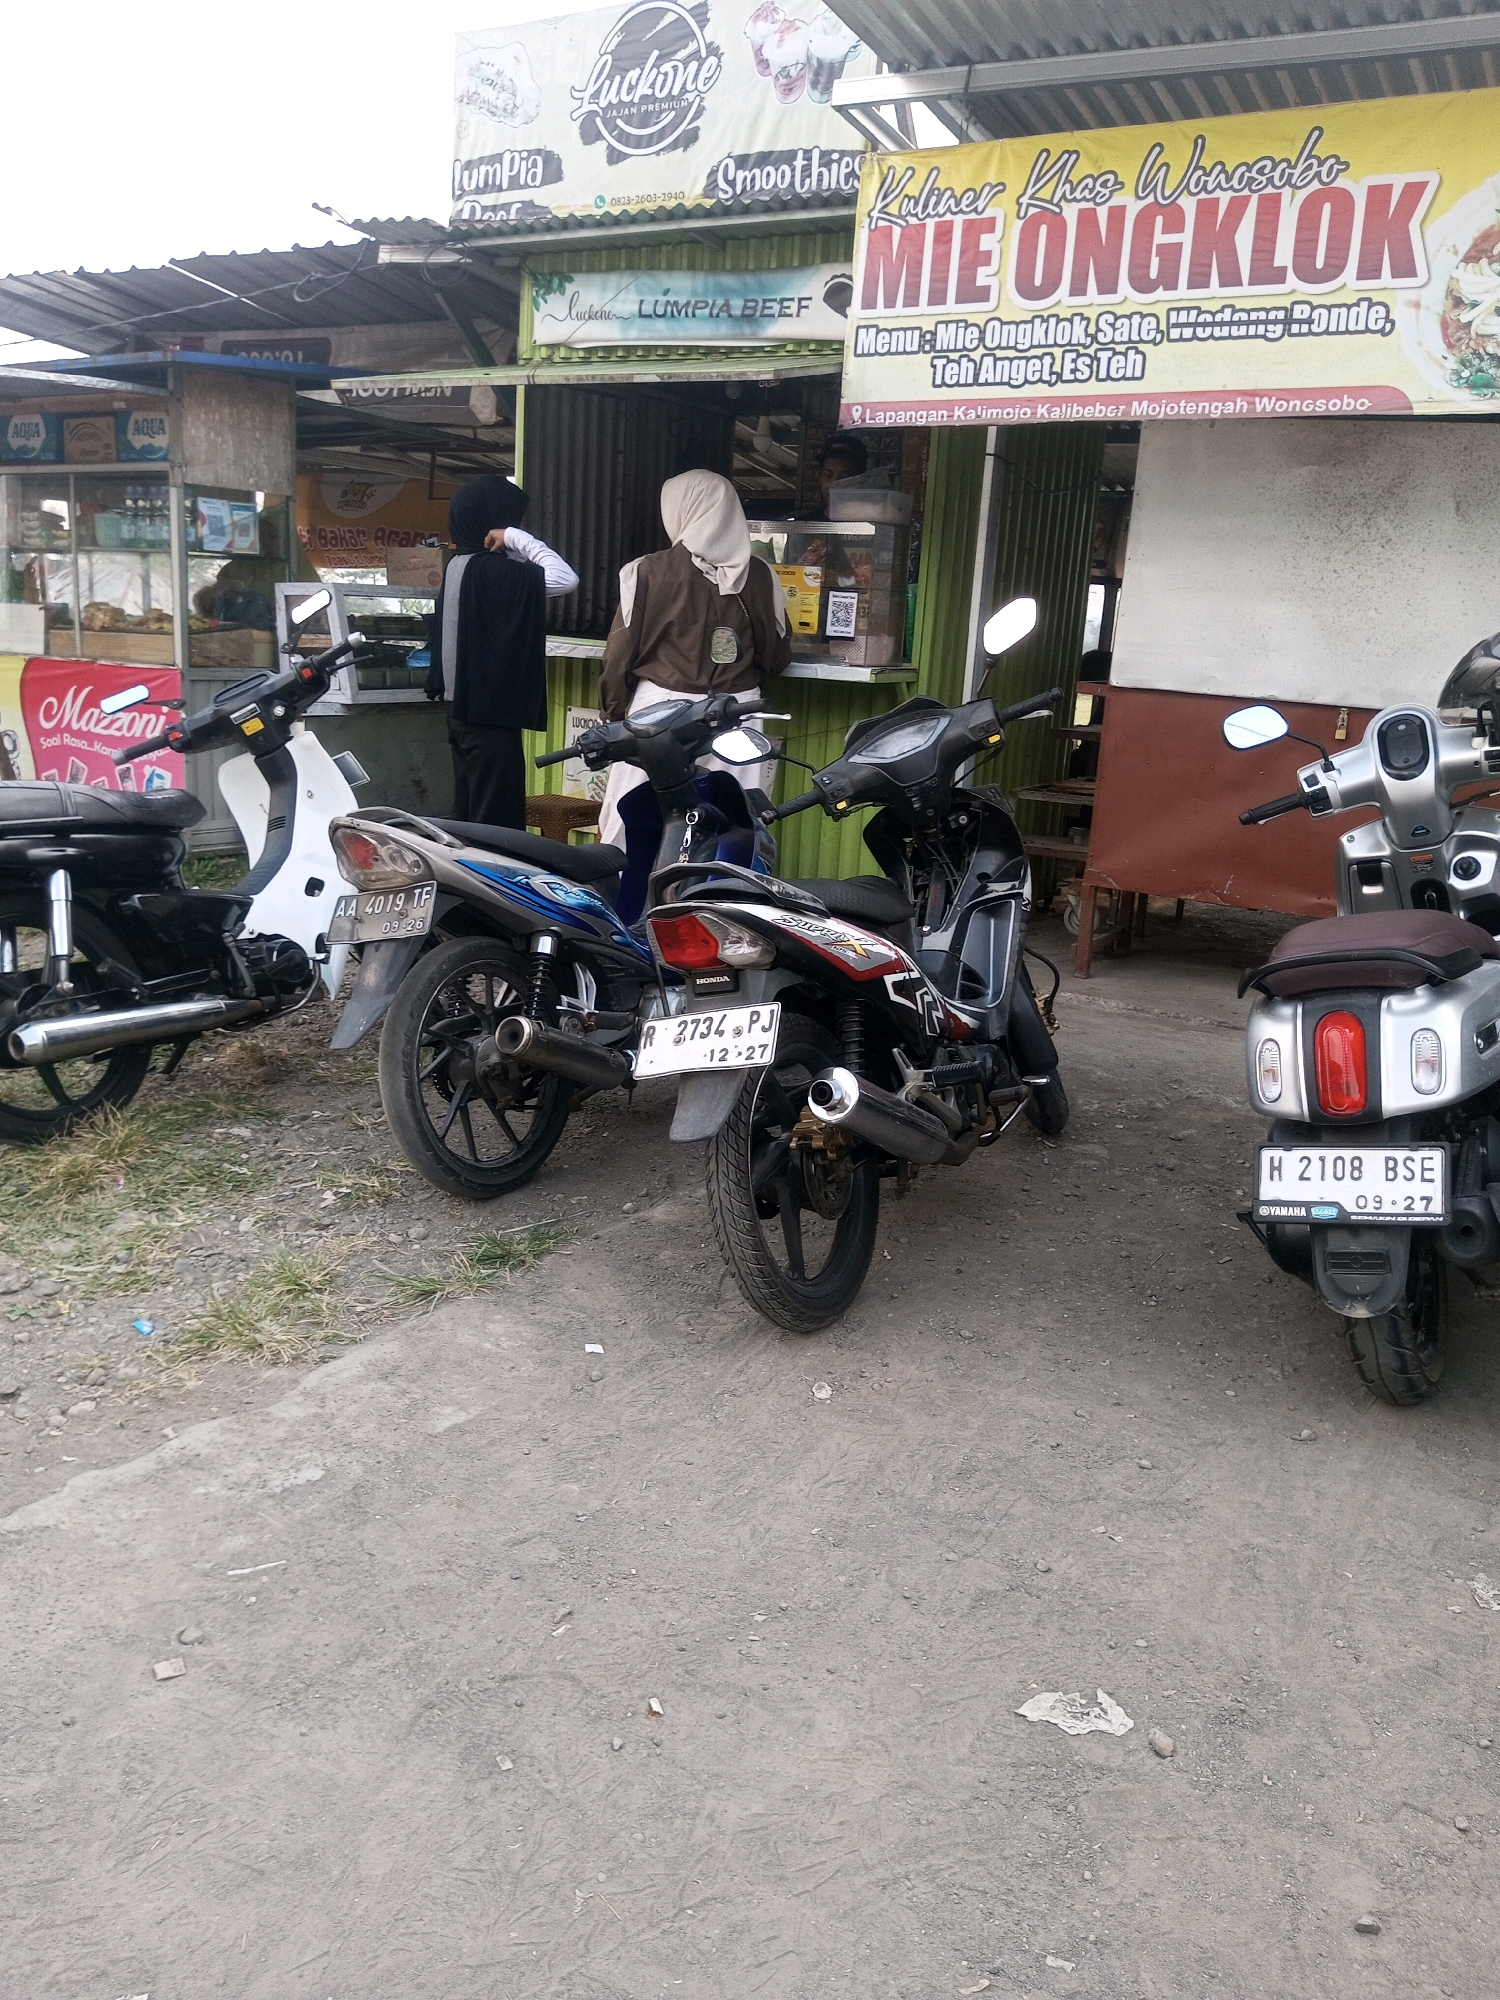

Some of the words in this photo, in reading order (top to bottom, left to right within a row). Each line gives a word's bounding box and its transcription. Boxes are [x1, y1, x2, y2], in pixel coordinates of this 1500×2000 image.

[570, 50, 722, 121] Luckone
[606, 107, 637, 118] JAJAN
[641, 99, 688, 113] PREMIUM
[870, 167, 1005, 231] Kuliner
[1017, 148, 1124, 219] Khas
[1136, 126, 1349, 207] Wonosobo
[860, 216, 997, 311] MIE
[1014, 180, 1430, 302] ONGKLOK
[638, 298, 733, 319] LUMPIA
[740, 296, 813, 318] BEEF
[856, 328, 920, 354] Menu
[935, 322, 979, 350] Mie
[984, 316, 1091, 350] Ongklok,
[1097, 313, 1162, 344] Sate,
[1290, 301, 1392, 334] Ronde,
[933, 357, 975, 385] Teh
[979, 355, 1057, 387] Anget,
[1062, 352, 1091, 381] Es
[1097, 350, 1143, 379] Teh
[866, 407, 948, 426] Lapangan
[953, 405, 1034, 422] Kalimojo
[1131, 398, 1248, 419] Mojotengah
[12, 422, 41, 441] AQUA
[132, 418, 167, 438] AQUA
[39, 685, 169, 739] Mazzoni
[335, 899, 357, 918] AA
[365, 893, 405, 915] 4019
[413, 886, 432, 908] TF
[695, 975, 731, 985] HONDA
[643, 1026, 656, 1049] R
[747, 1009, 775, 1033] PJ
[1269, 1155, 1283, 1182] H
[1298, 1155, 1363, 1182] 2108
[1384, 1155, 1435, 1183] BSE
[1269, 1205, 1307, 1217] YAMAHA
